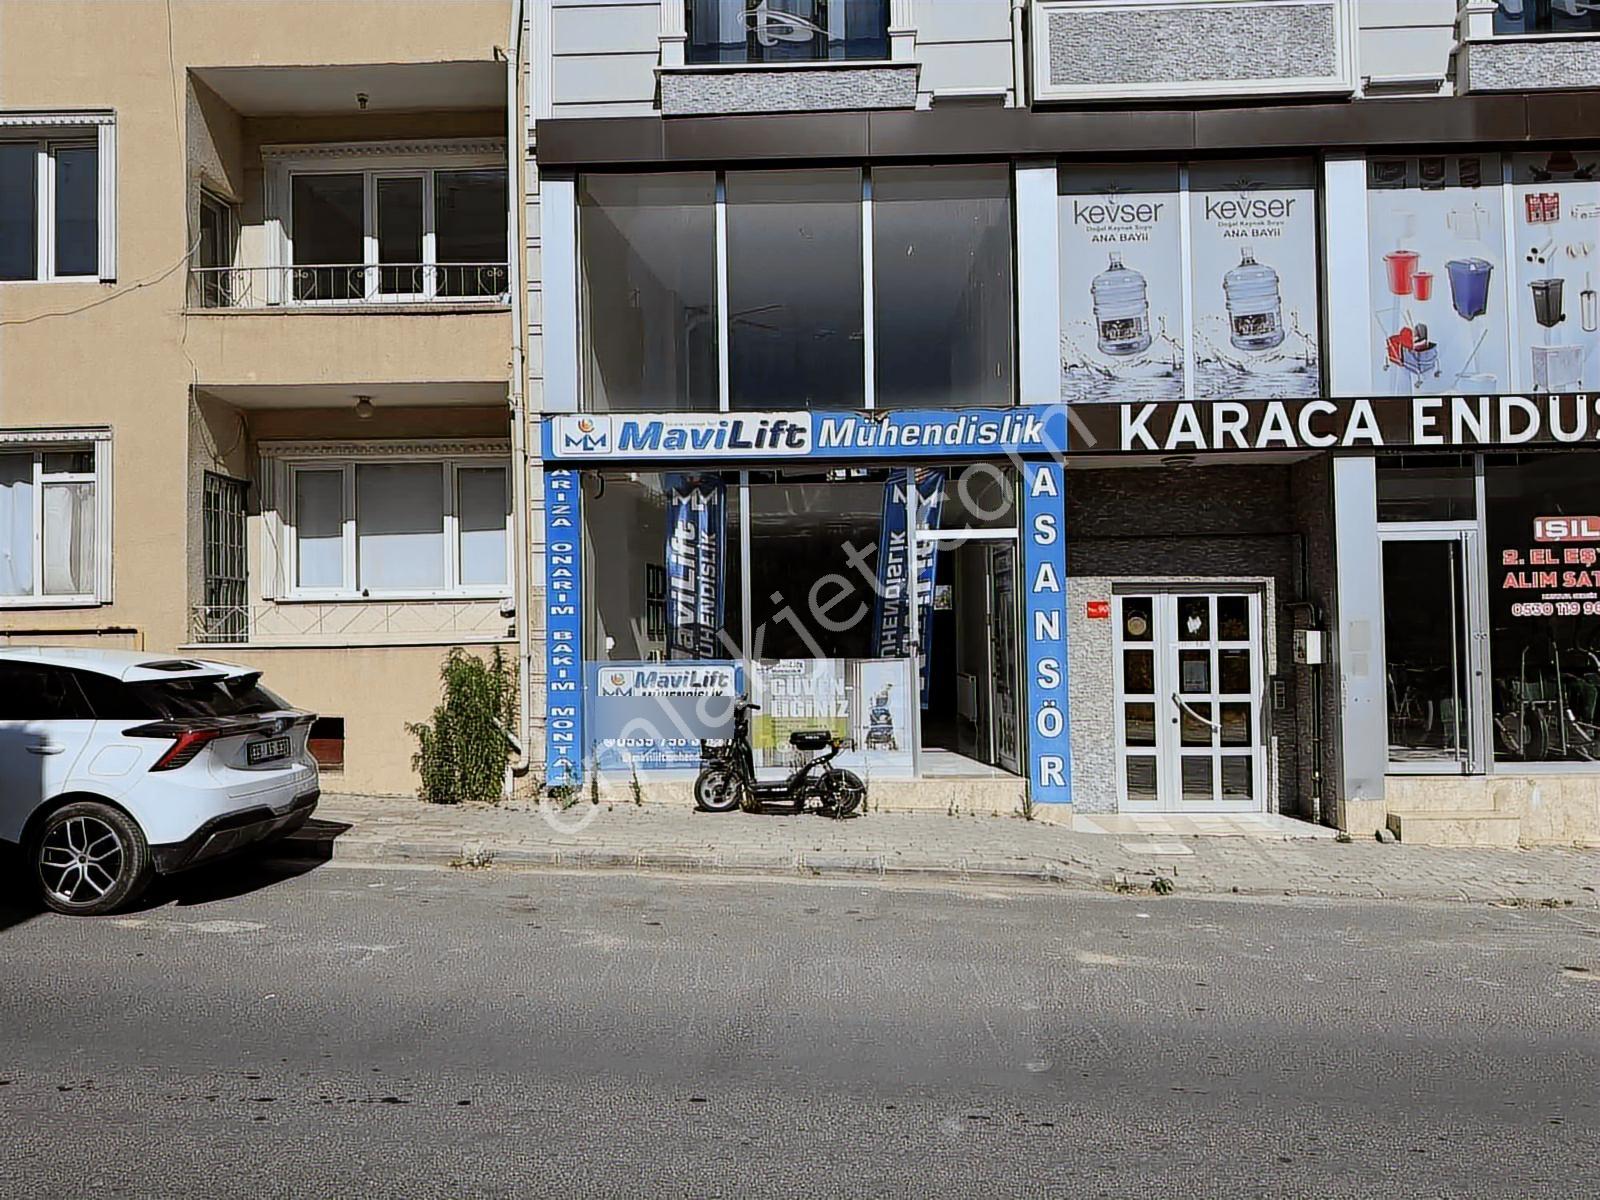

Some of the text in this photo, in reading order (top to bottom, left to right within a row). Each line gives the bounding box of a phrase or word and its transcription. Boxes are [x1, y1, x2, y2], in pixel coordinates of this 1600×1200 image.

[1074, 200, 1164, 224] kevser
[1205, 196, 1296, 220] kevser
[1091, 234, 1117, 243] ANA
[1223, 229, 1249, 238] ANA
[618, 414, 1044, 450] MaviLift Mühendislik
[1119, 399, 1385, 450] KARACA
[1529, 548, 1560, 565] EL
[1563, 548, 1600, 568] EŞ
[551, 543, 575, 615] ONARIM
[1503, 571, 1558, 589] ALIM
[696, 530, 717, 659] ÜHENDİSLİK
[1030, 466, 1066, 788] ASANSÖR
[551, 631, 575, 691] BAKIM
[635, 670, 729, 688] MaviLift
